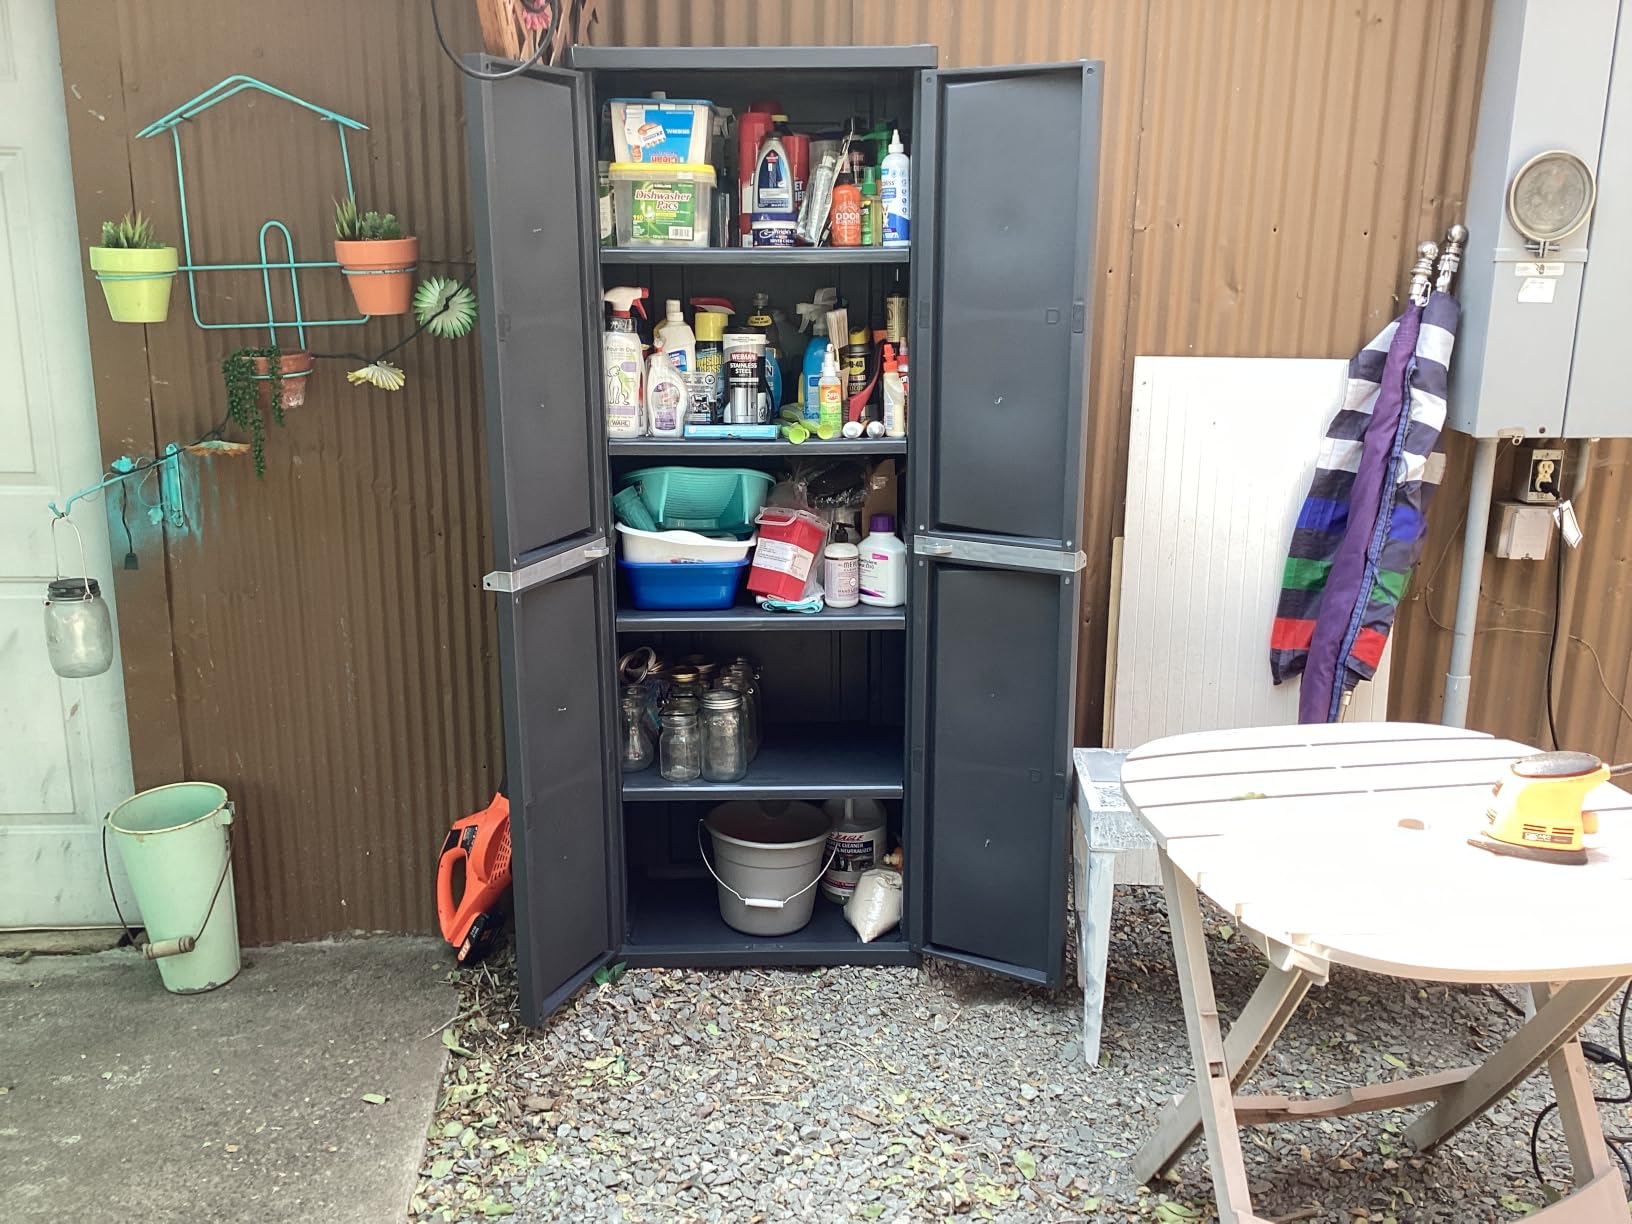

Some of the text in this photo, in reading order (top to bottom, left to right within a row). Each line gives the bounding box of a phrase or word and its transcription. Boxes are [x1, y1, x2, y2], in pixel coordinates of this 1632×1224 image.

[635, 190, 690, 201] Dishwasher
[657, 201, 678, 209] Pacs
[835, 212, 860, 220] ODOR
[848, 360, 864, 368] D-40
